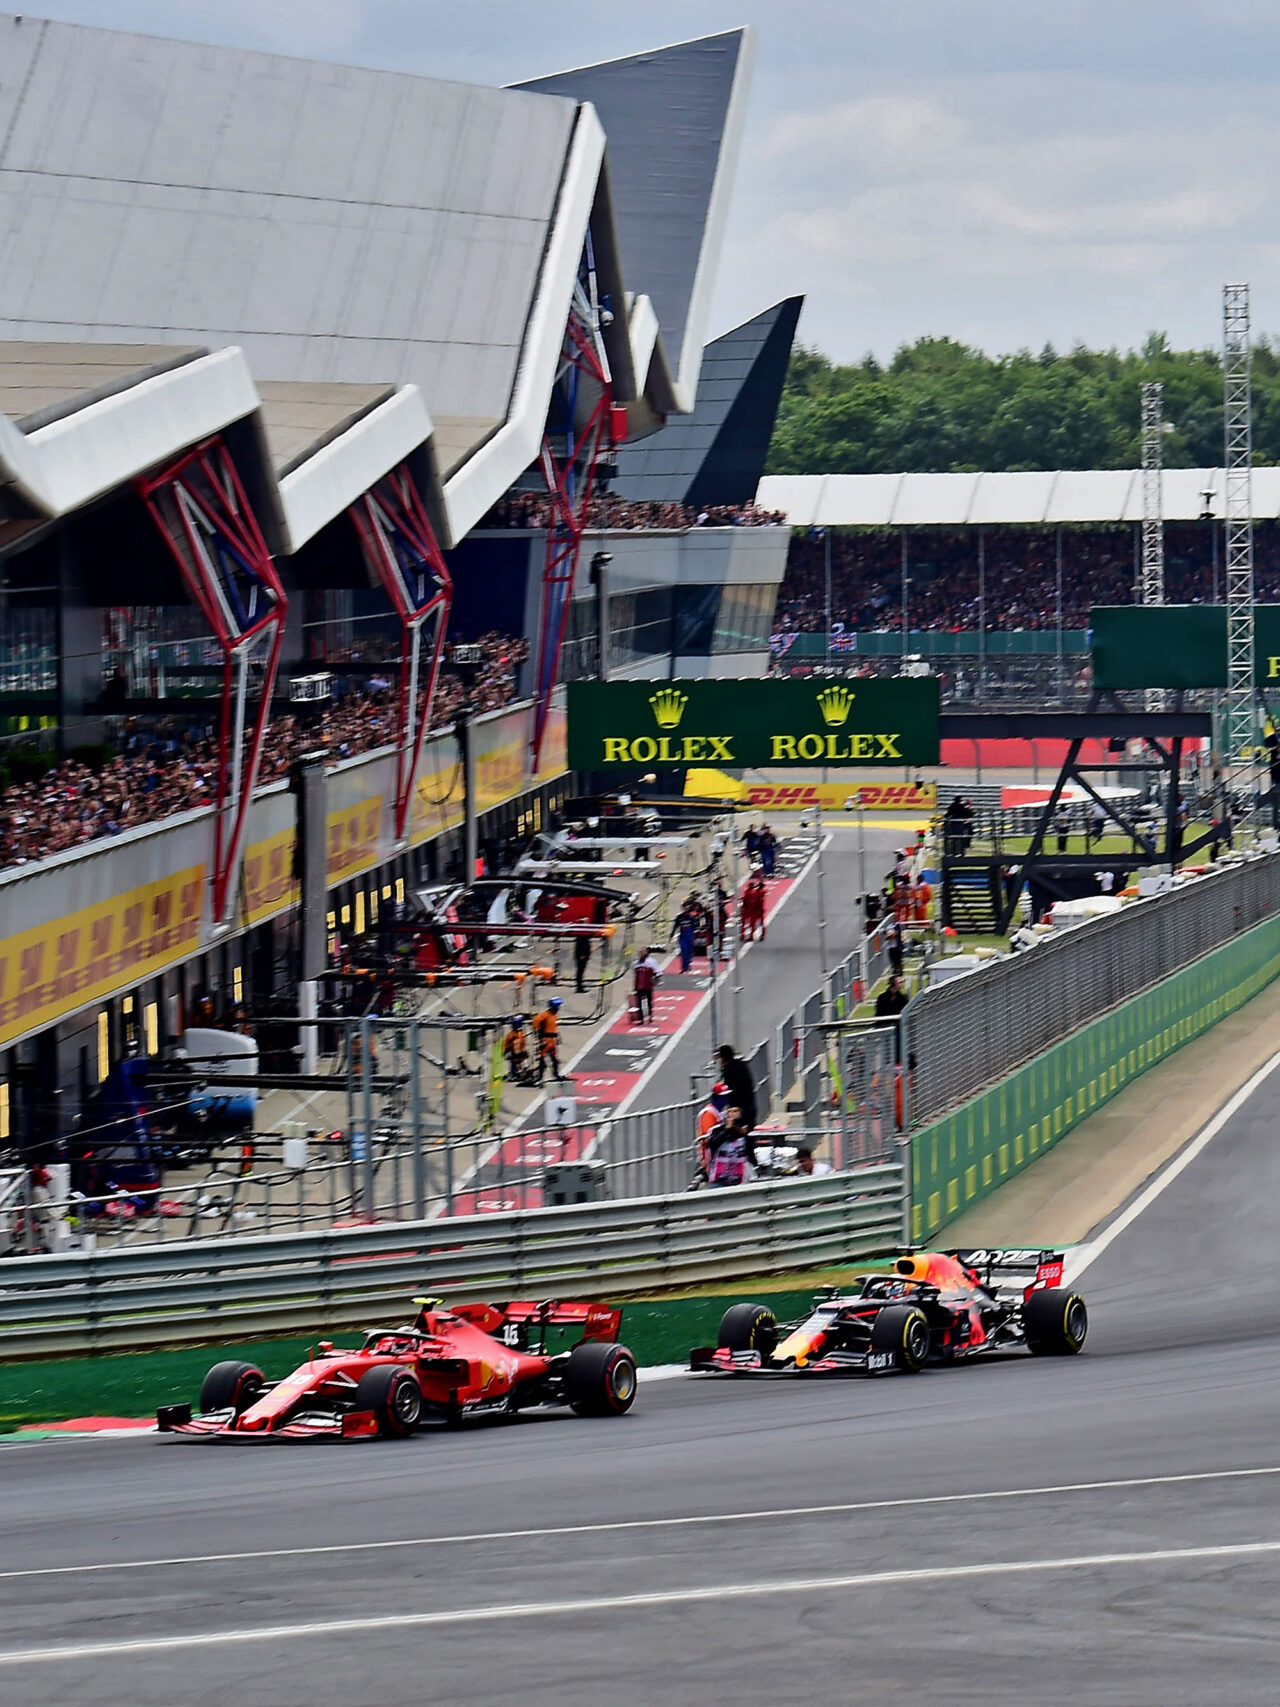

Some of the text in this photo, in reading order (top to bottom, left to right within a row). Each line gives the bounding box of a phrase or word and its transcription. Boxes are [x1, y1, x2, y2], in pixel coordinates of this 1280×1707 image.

[602, 735, 735, 762] ROLEX
[770, 734, 902, 760] ROLEX
[747, 787, 820, 805] DHL
[857, 787, 922, 804] DHL
